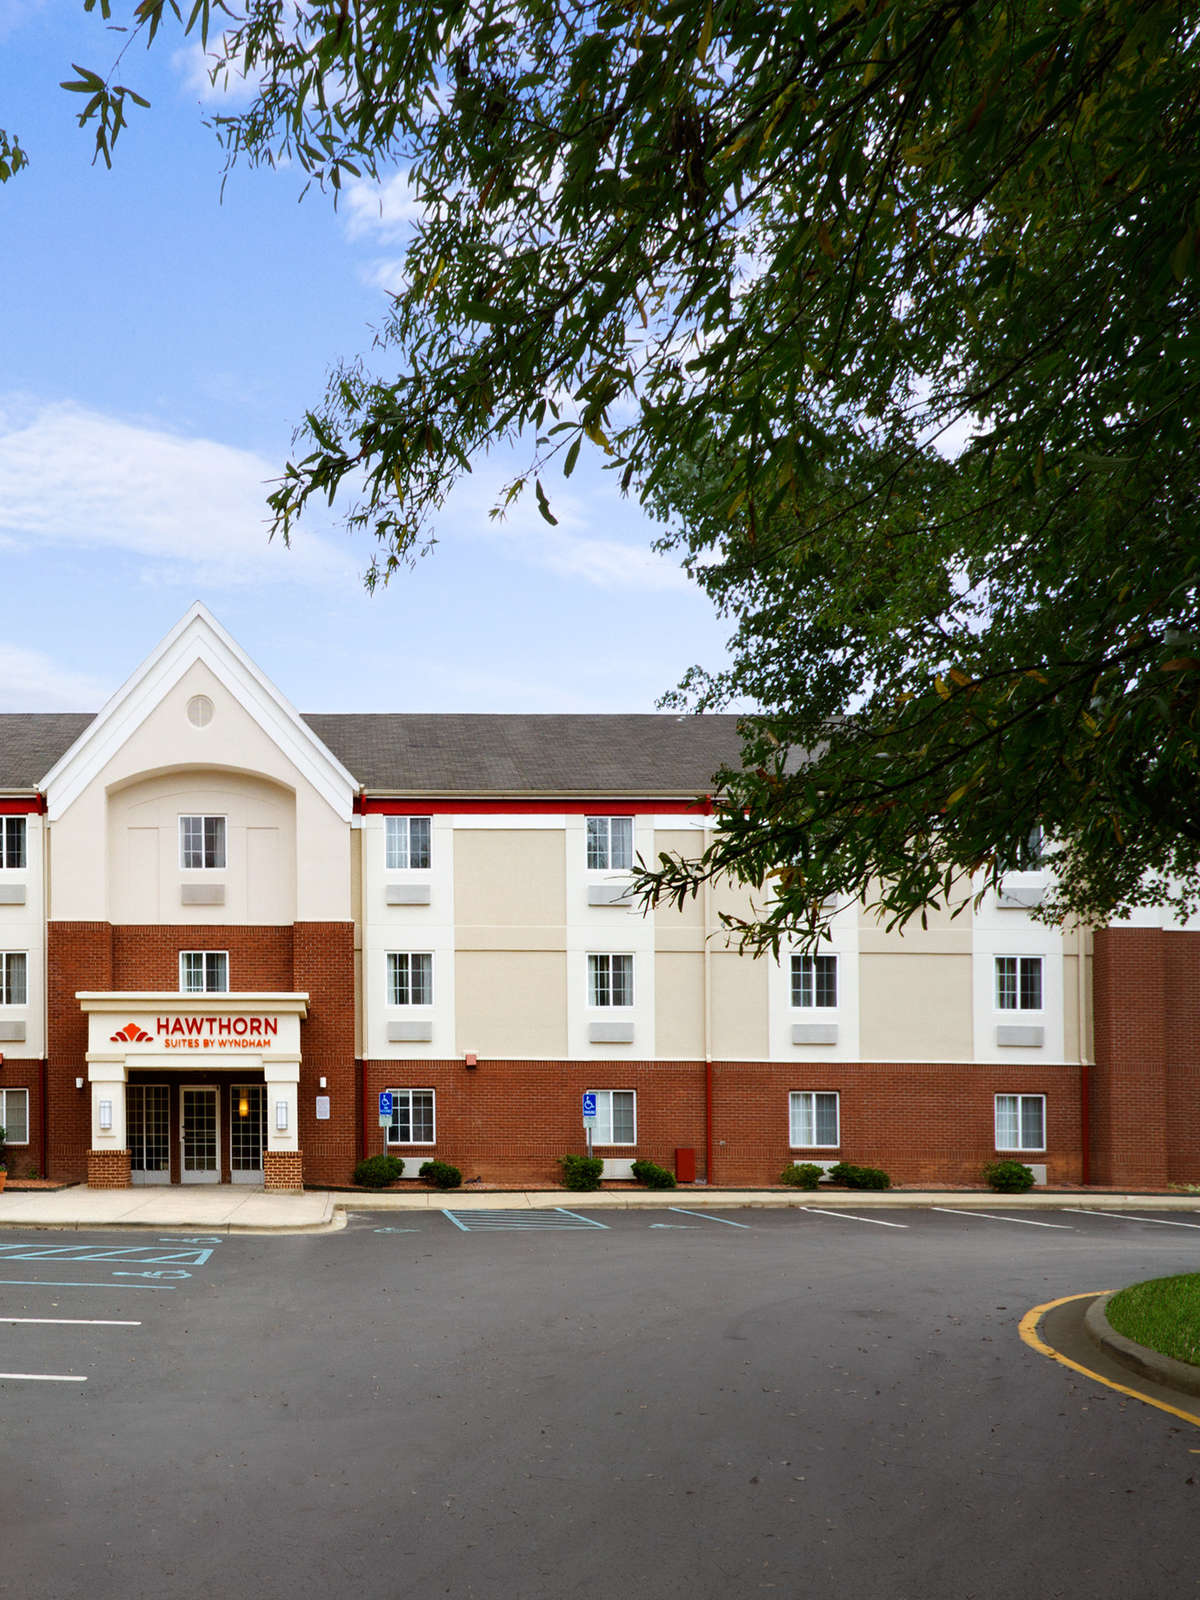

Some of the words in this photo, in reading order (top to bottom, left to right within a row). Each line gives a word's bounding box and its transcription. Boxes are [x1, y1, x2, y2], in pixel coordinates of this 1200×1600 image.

[156, 1017, 278, 1035] HAWTHORN
[164, 1038, 200, 1048] SUITES
[203, 1038, 216, 1048] BY
[217, 1038, 271, 1048] WYNDHAM
